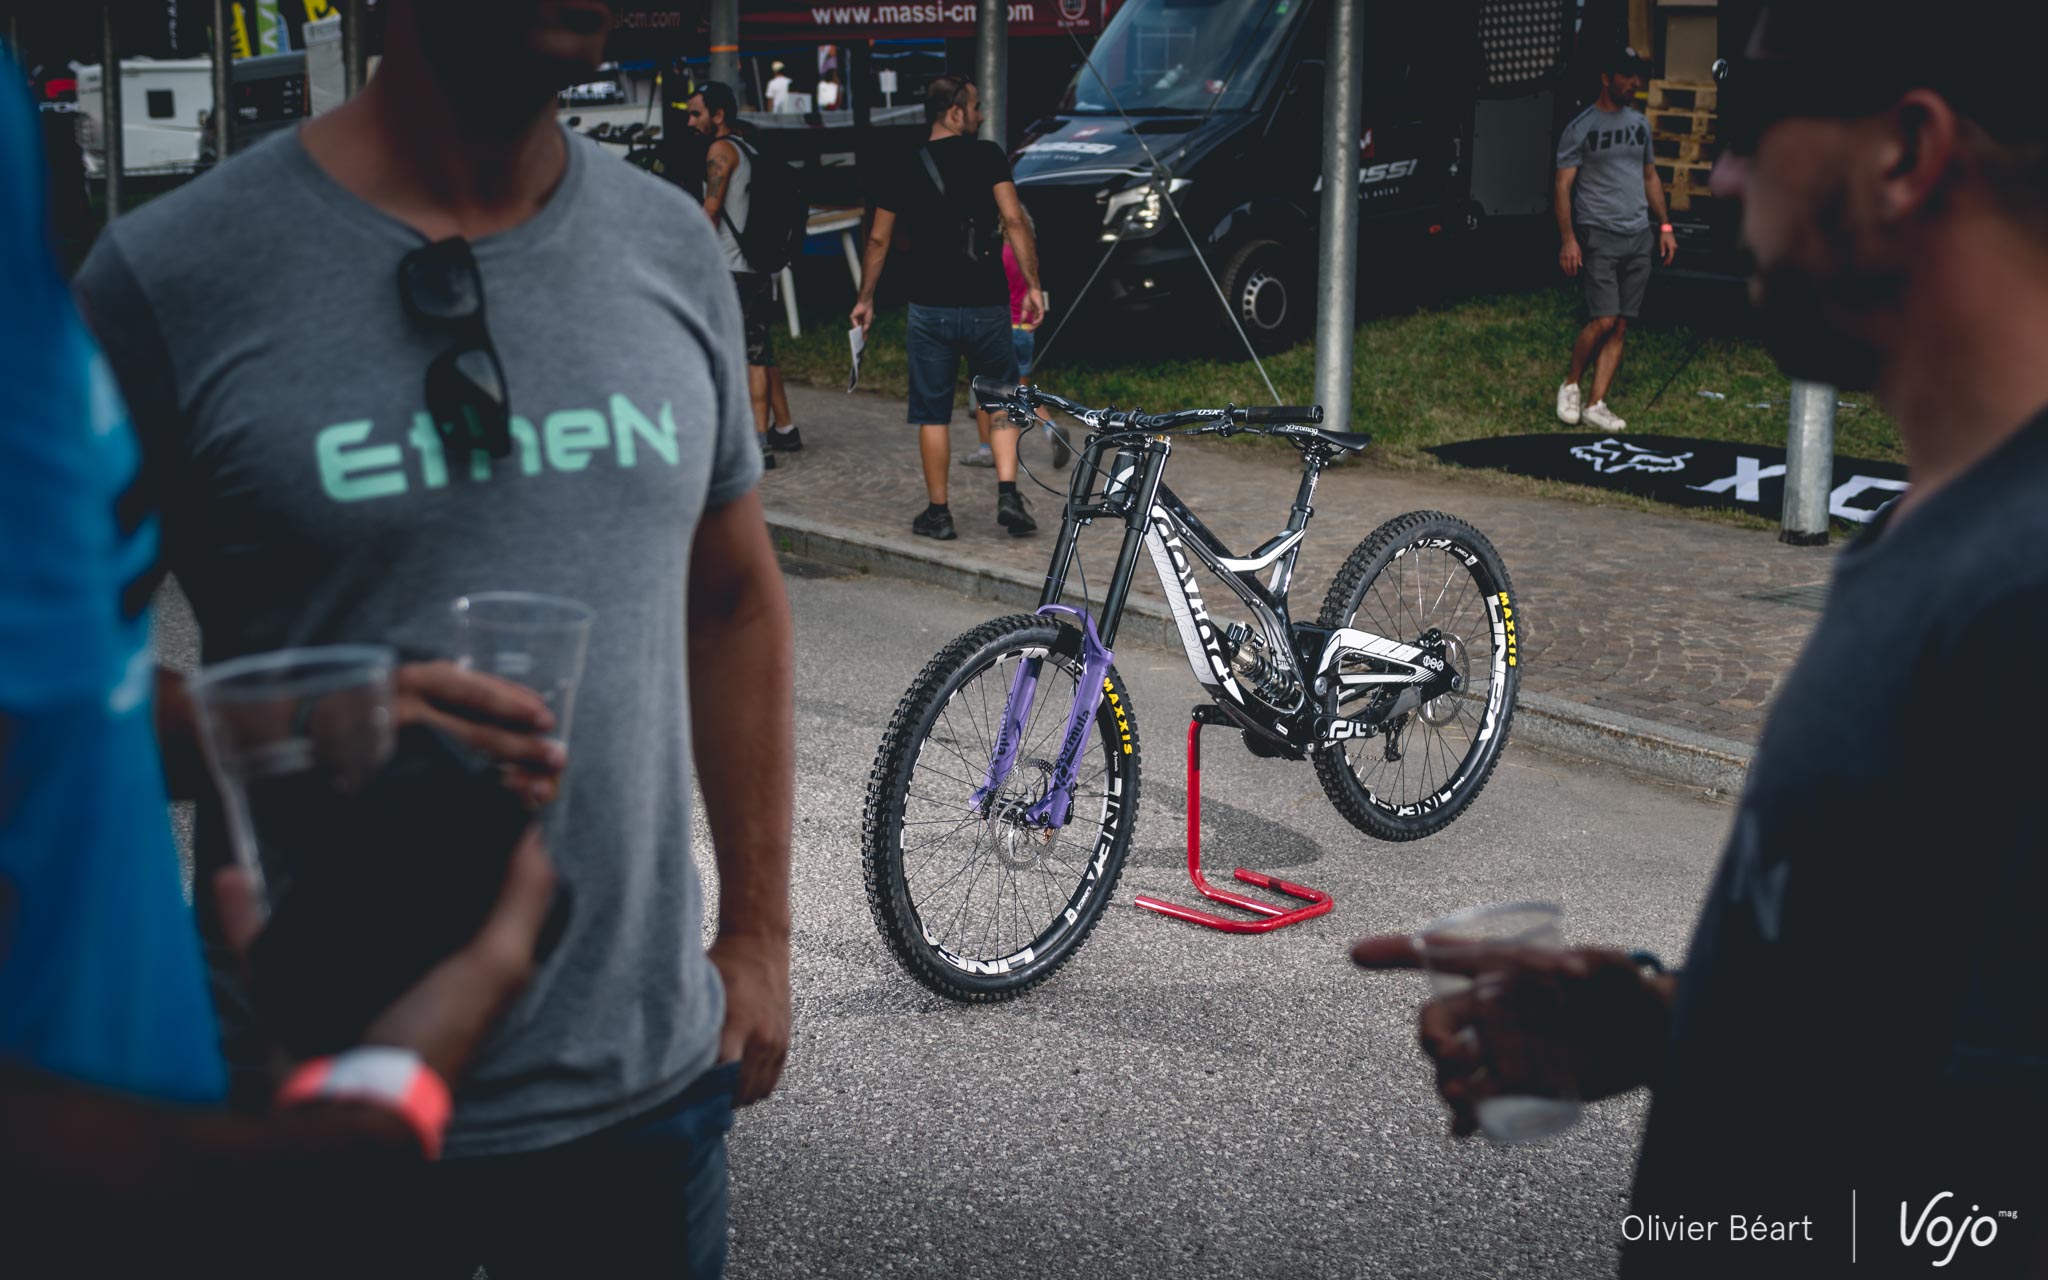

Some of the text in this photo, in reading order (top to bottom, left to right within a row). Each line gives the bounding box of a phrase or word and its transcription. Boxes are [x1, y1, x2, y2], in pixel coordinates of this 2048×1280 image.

[1595, 124, 1644, 150] FOX
[1498, 591, 1517, 667] MAXXIS
[1103, 677, 1133, 755] MAXXIS
